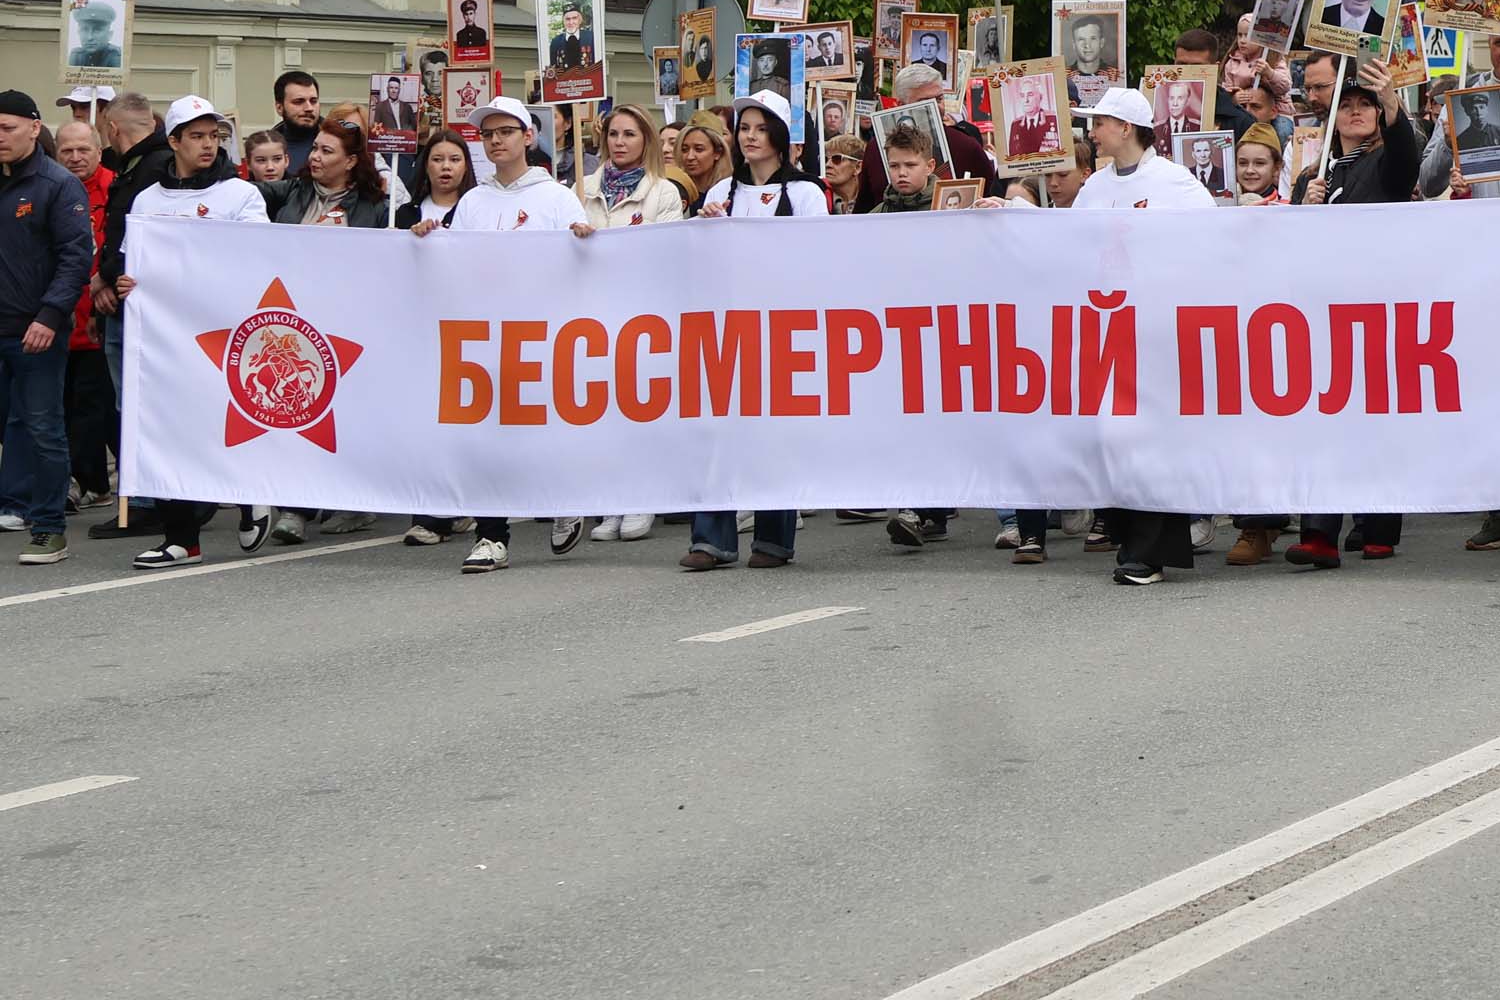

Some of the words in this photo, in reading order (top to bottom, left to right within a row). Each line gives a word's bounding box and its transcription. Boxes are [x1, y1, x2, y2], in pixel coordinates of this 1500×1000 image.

[234, 330, 247, 350] ЛЕТ
[245, 313, 299, 332] ВЕЛИКОЙ
[301, 323, 335, 371] ПОБЕДЫ
[440, 290, 1137, 426] БЕССМЕРТНЫЙ
[1178, 303, 1462, 417] ПОЛК
[254, 410, 275, 424] 1941
[291, 410, 312, 424] 1945
